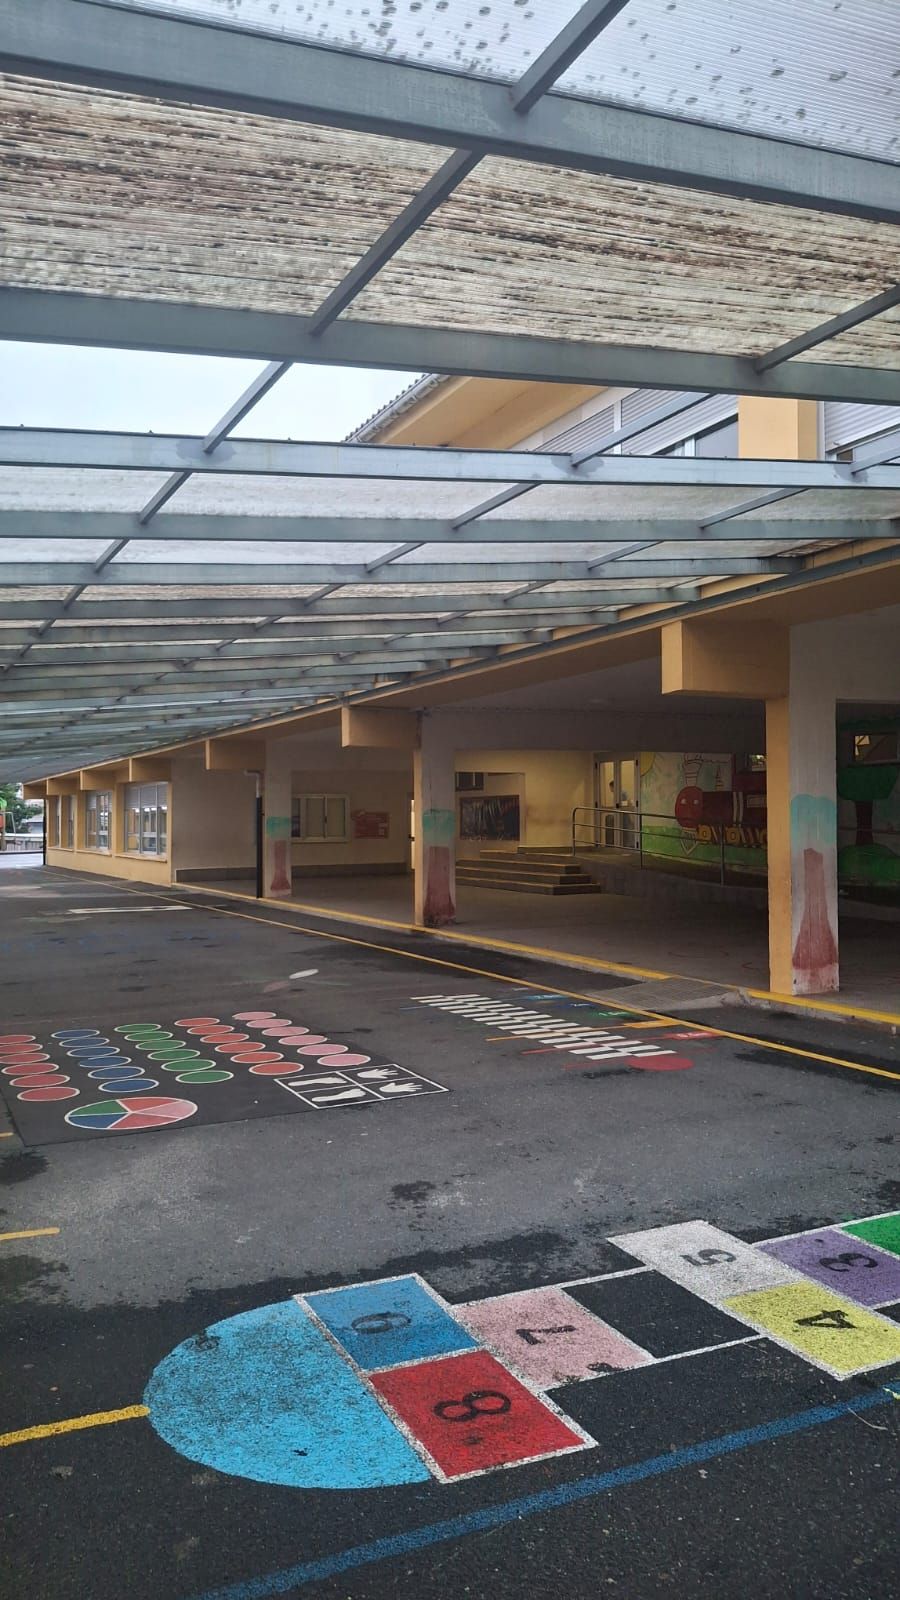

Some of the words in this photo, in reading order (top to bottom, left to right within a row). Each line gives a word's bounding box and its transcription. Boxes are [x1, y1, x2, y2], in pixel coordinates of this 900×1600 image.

[680, 1248, 736, 1267] 5
[819, 1252, 878, 1273] 3
[795, 1309, 857, 1329] 4
[433, 1389, 512, 1422] 8
